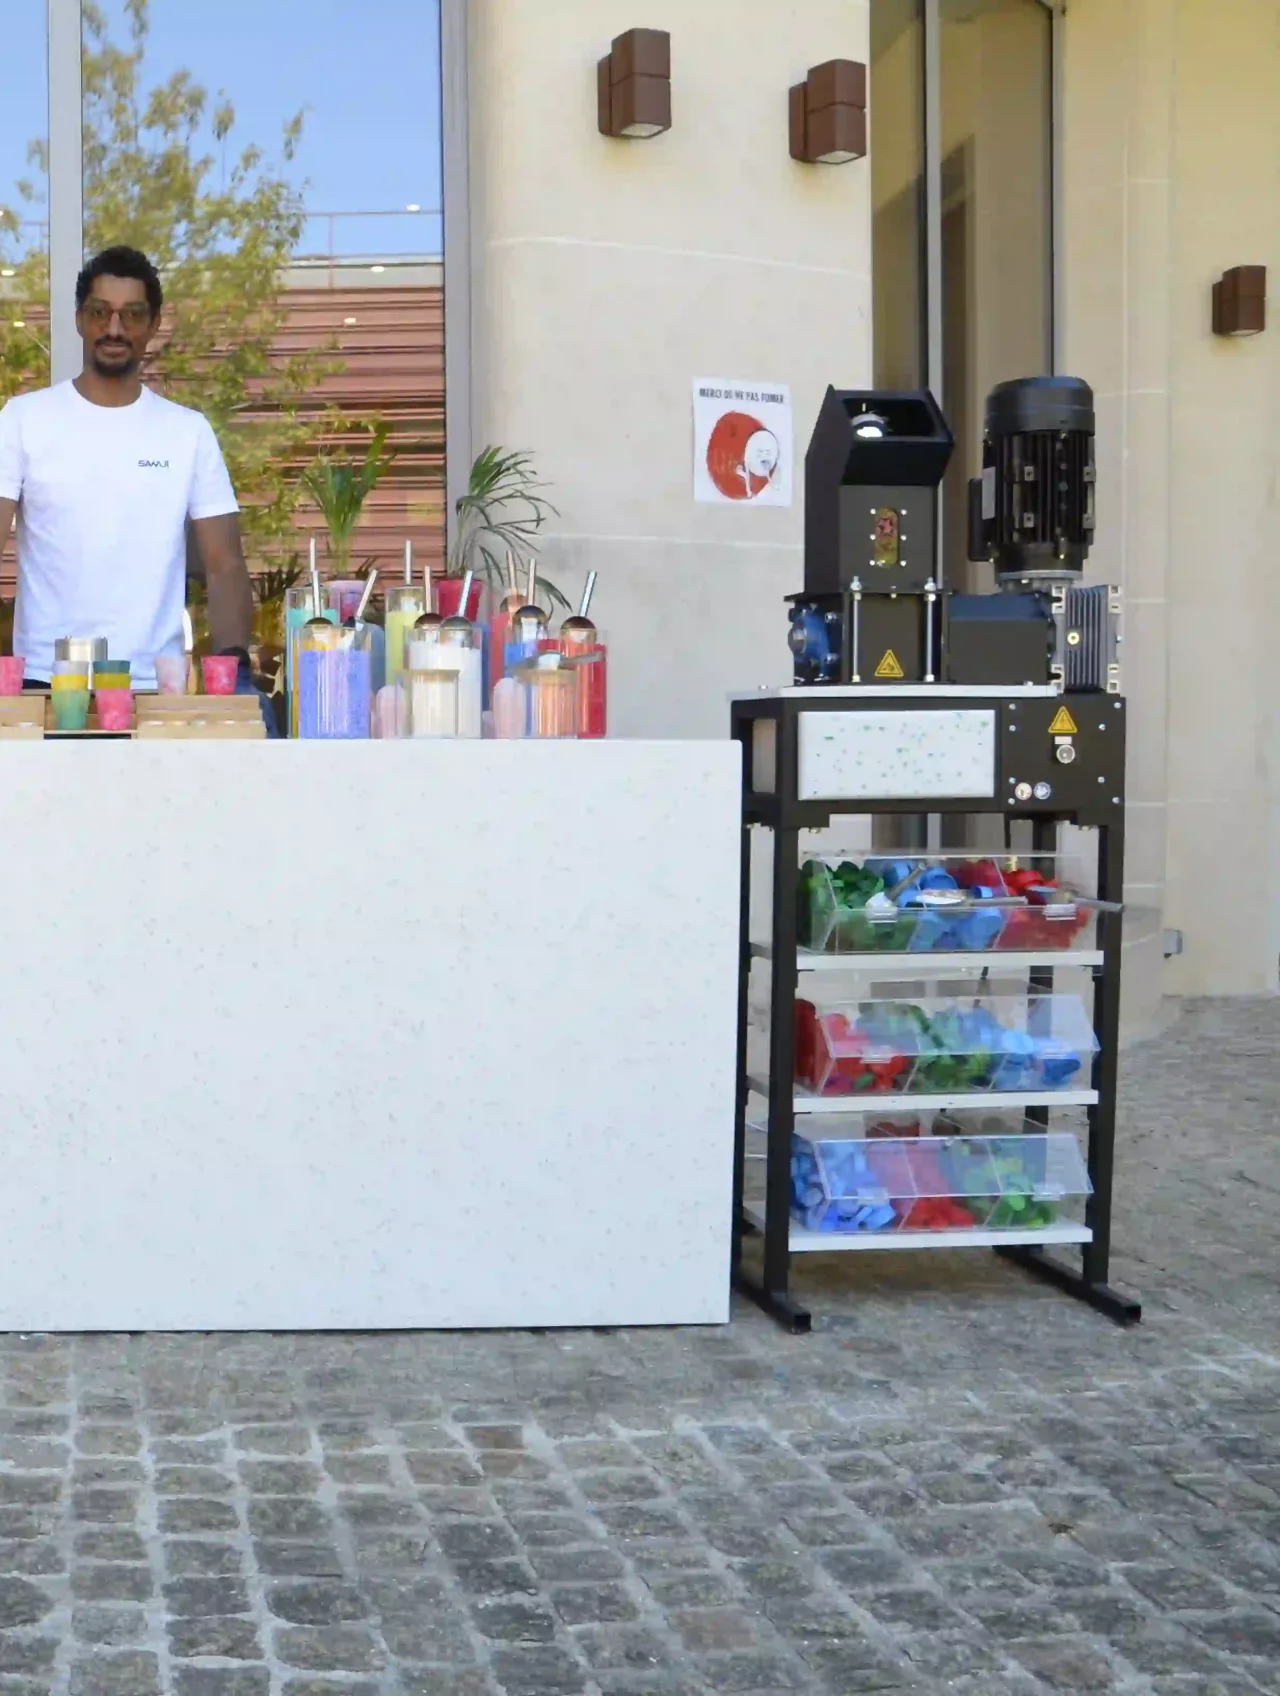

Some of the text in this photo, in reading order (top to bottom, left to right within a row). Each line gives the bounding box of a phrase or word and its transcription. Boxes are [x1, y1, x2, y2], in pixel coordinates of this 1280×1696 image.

[699, 387, 722, 399] MERCI
[745, 391, 759, 402] PAS
[137, 459, 170, 469] SAMJI
